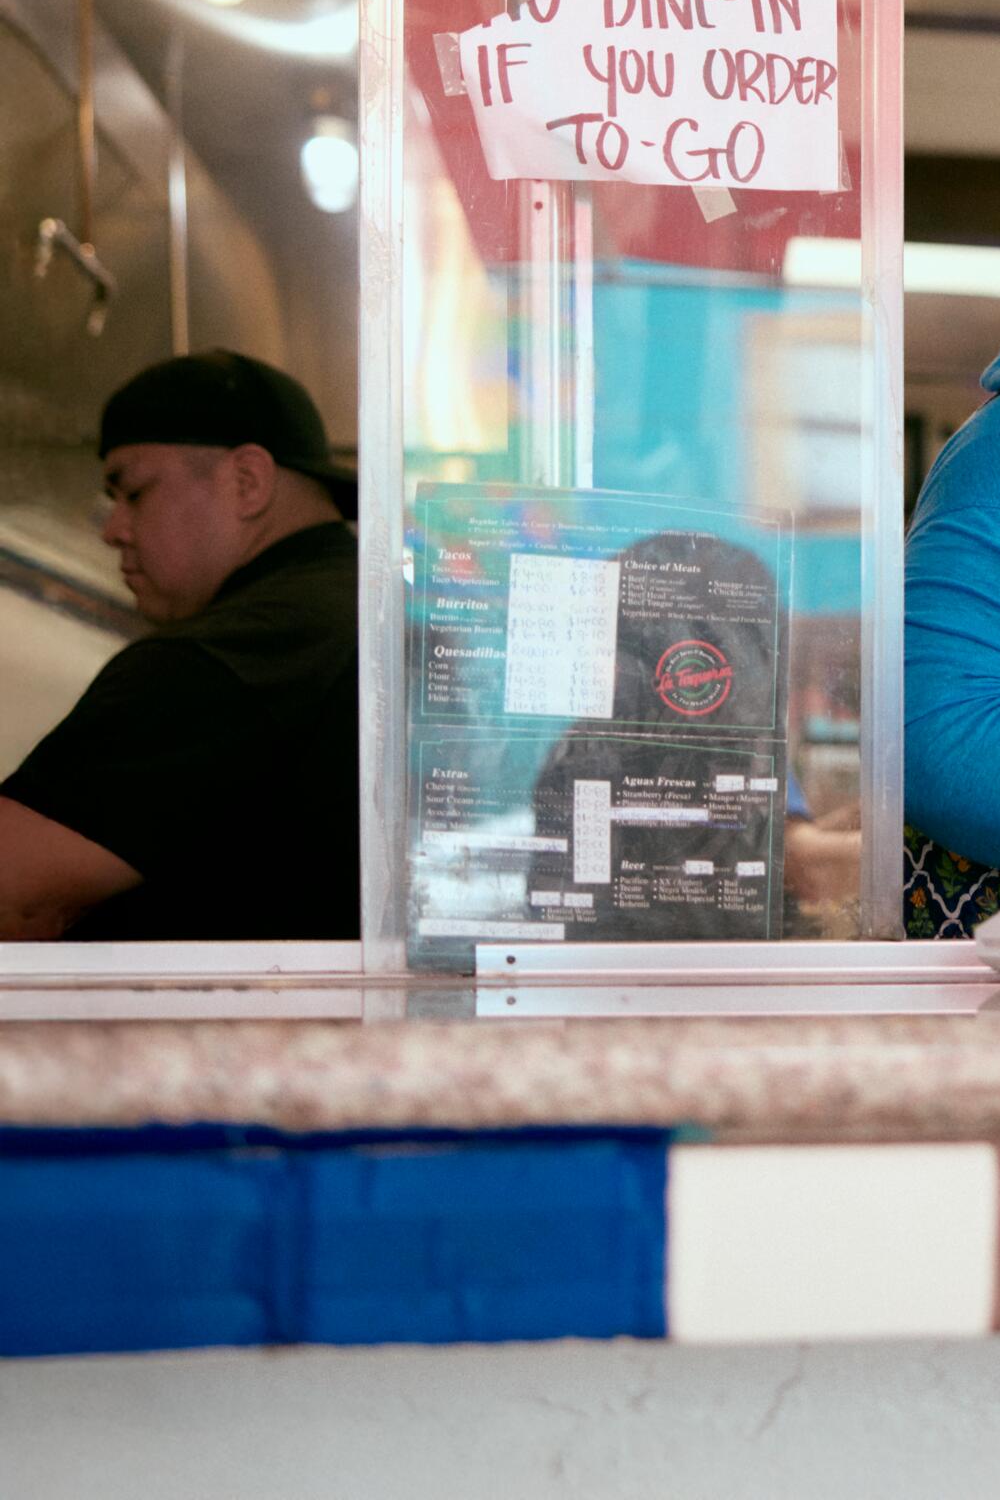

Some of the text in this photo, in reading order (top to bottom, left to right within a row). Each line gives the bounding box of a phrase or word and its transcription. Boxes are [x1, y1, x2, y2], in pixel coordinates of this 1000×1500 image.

[477, 43, 836, 117] IF YOU ORDER
[546, 112, 766, 183] TO-GO
[437, 548, 472, 560] Tacos
[624, 560, 702, 574] Choice of Meats
[647, 592, 666, 600] Head
[713, 588, 743, 597] Chicken
[436, 597, 489, 611] Burritos
[430, 623, 472, 634] Vegetarian
[434, 644, 508, 659] Quesadillas
[428, 661, 448, 670] Corn
[428, 672, 450, 680] Flour
[428, 683, 448, 691] Corn
[428, 693, 450, 702] Flour
[432, 767, 469, 780] Extras
[622, 775, 654, 788] Aguas
[657, 777, 697, 788] Frescas
[426, 795, 445, 803] Sour
[446, 796, 474, 805] Cream
[622, 790, 662, 800] Strawberry
[709, 793, 735, 802] Mango
[709, 802, 742, 812] Horchata
[621, 860, 646, 870] Beer
[620, 876, 649, 884] Pacifico
[660, 886, 680, 895] Negra
[740, 888, 758, 897] Light
[620, 892, 645, 900] Corona
[660, 894, 716, 904] Modelo Especial
[619, 900, 650, 908] Bohemia
[723, 903, 765, 912] Miller Light
